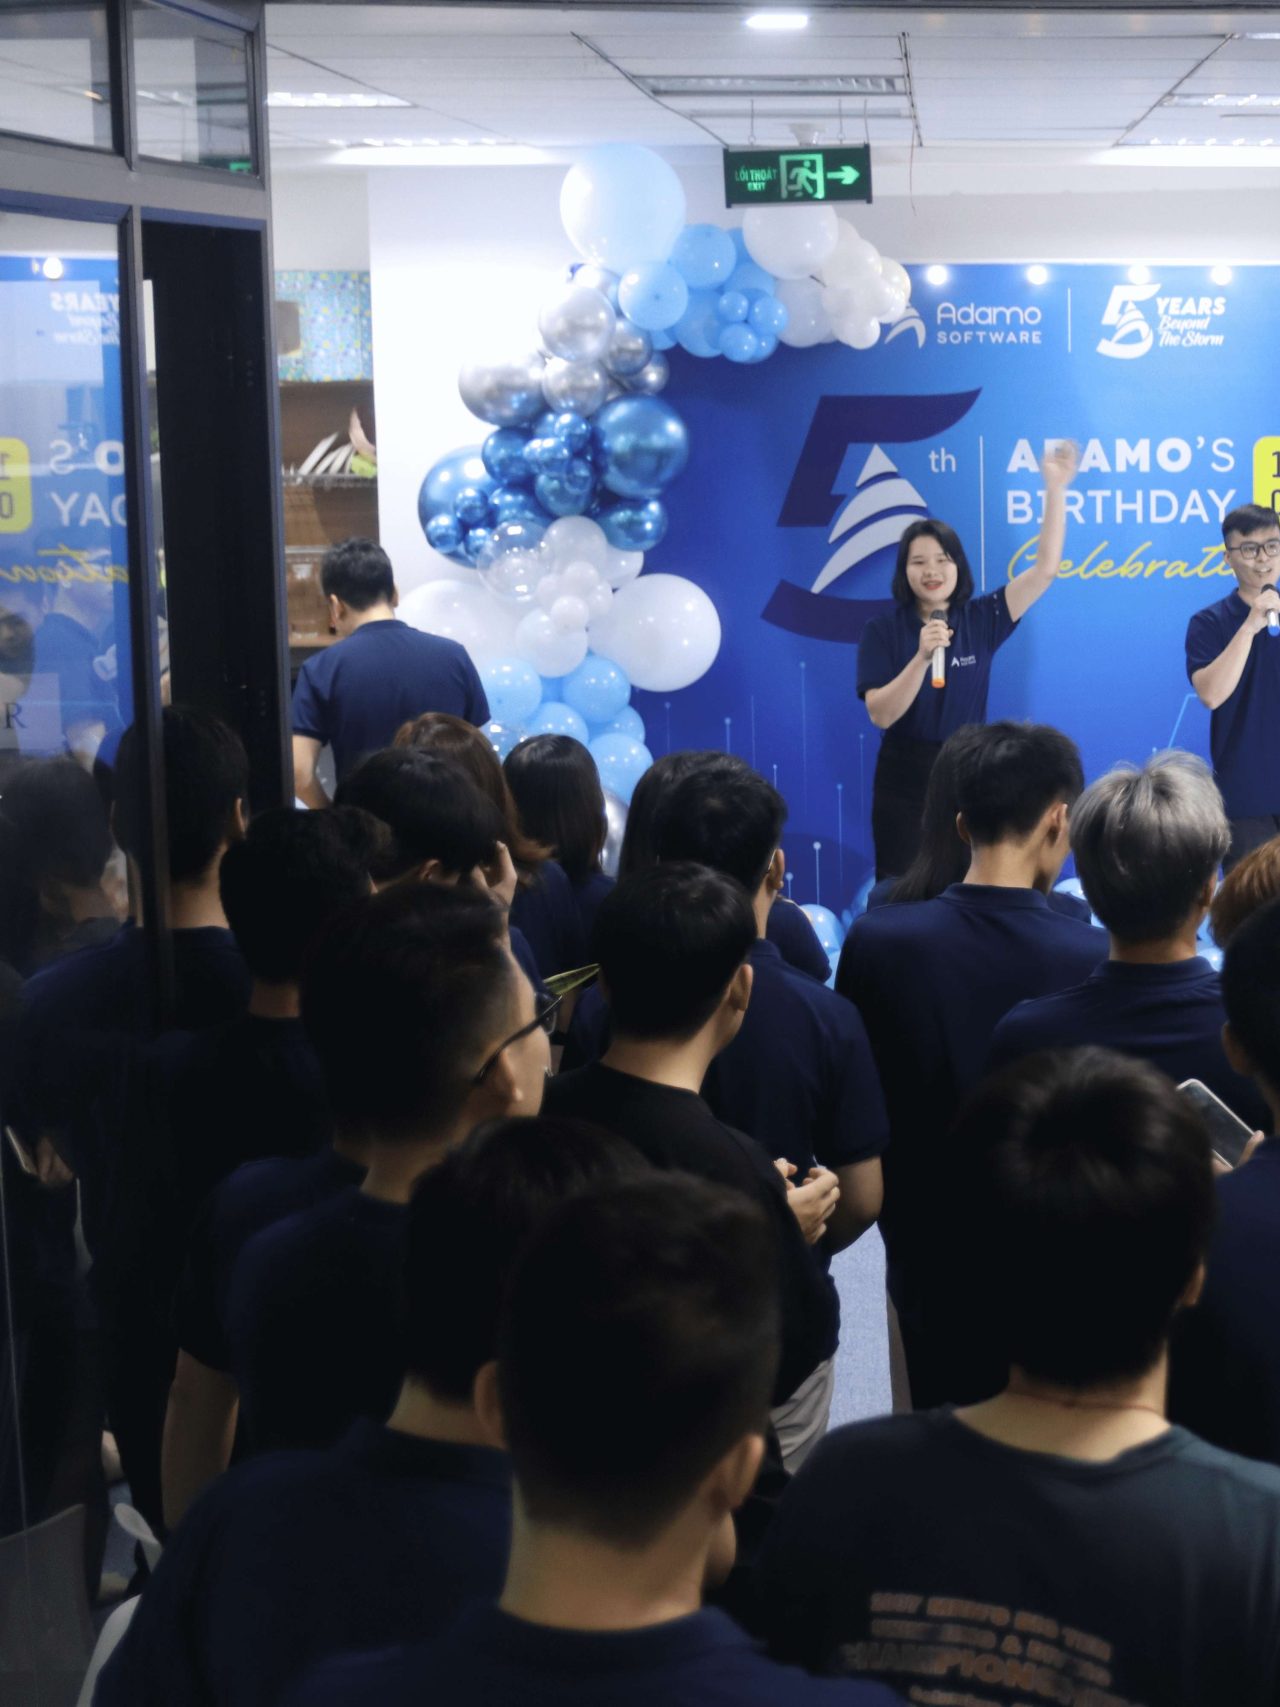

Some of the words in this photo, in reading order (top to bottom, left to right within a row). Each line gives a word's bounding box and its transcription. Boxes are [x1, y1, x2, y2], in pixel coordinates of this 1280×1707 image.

[937, 302, 1042, 325] Adamo
[1156, 297, 1226, 315] YEARS
[1158, 315, 1210, 334] Beyond
[937, 331, 1042, 344] SOFTWARE
[1159, 331, 1180, 347] The
[1181, 331, 1225, 348] Storm
